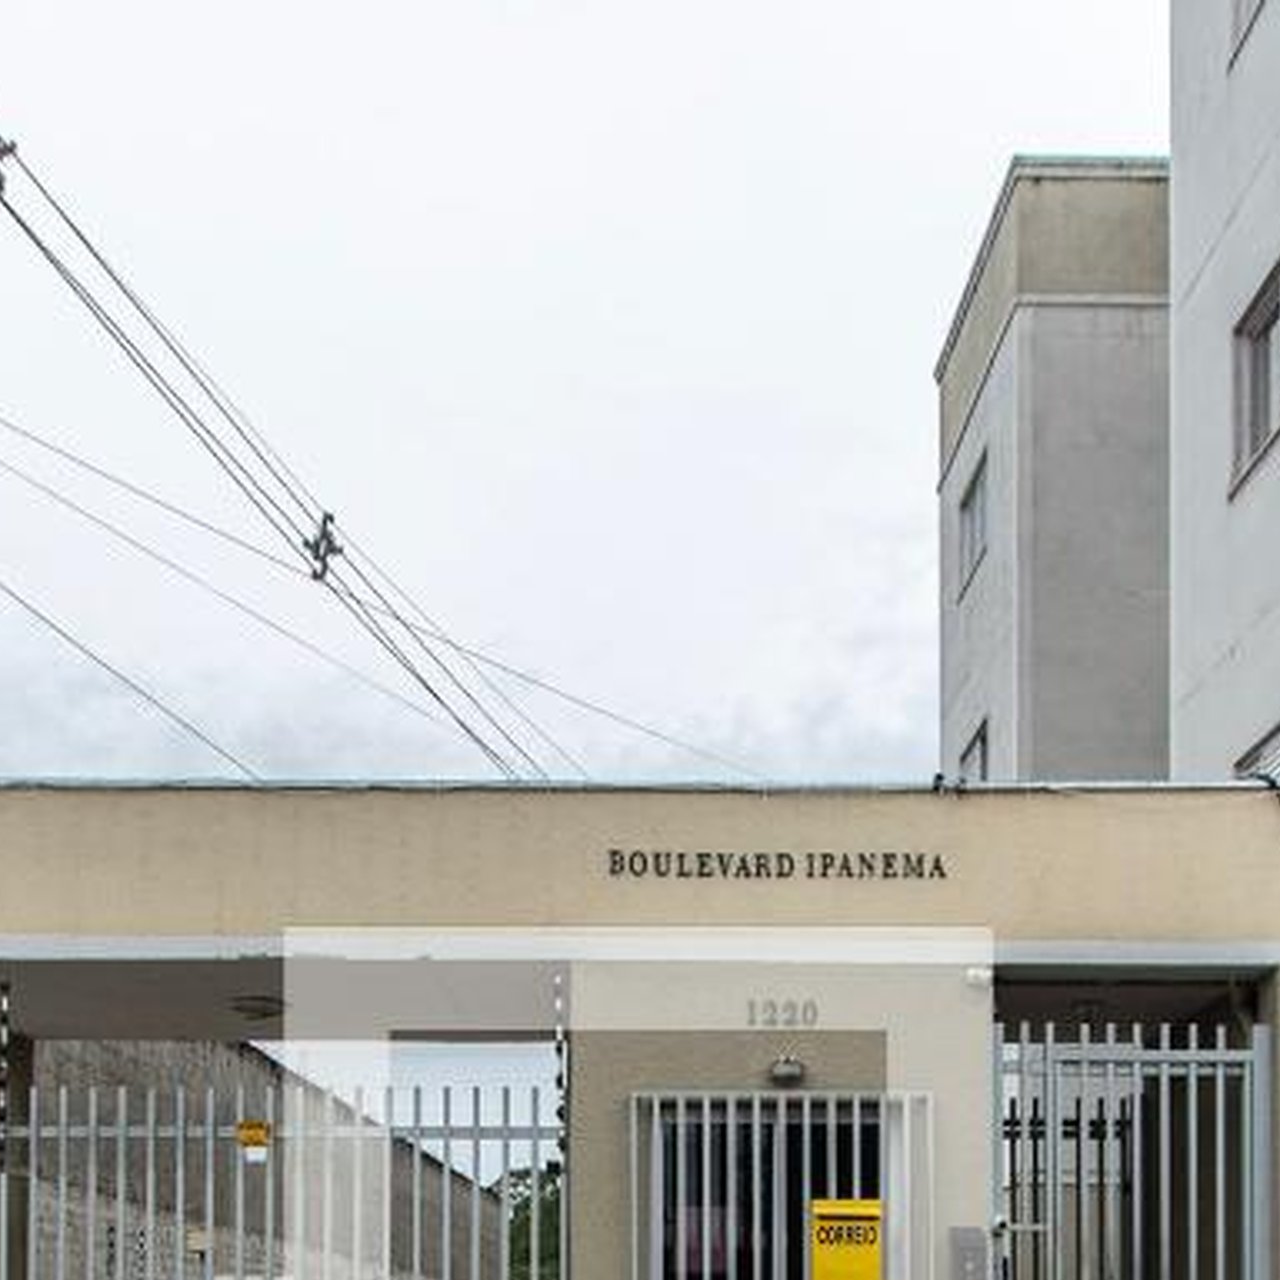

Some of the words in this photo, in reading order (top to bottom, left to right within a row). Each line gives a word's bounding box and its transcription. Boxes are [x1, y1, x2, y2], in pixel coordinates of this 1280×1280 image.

[608, 849, 796, 879] BOULEVARD
[806, 852, 948, 880] IPANEMA
[745, 999, 819, 1028] 1220
[815, 1225, 879, 1246] CORREIO
